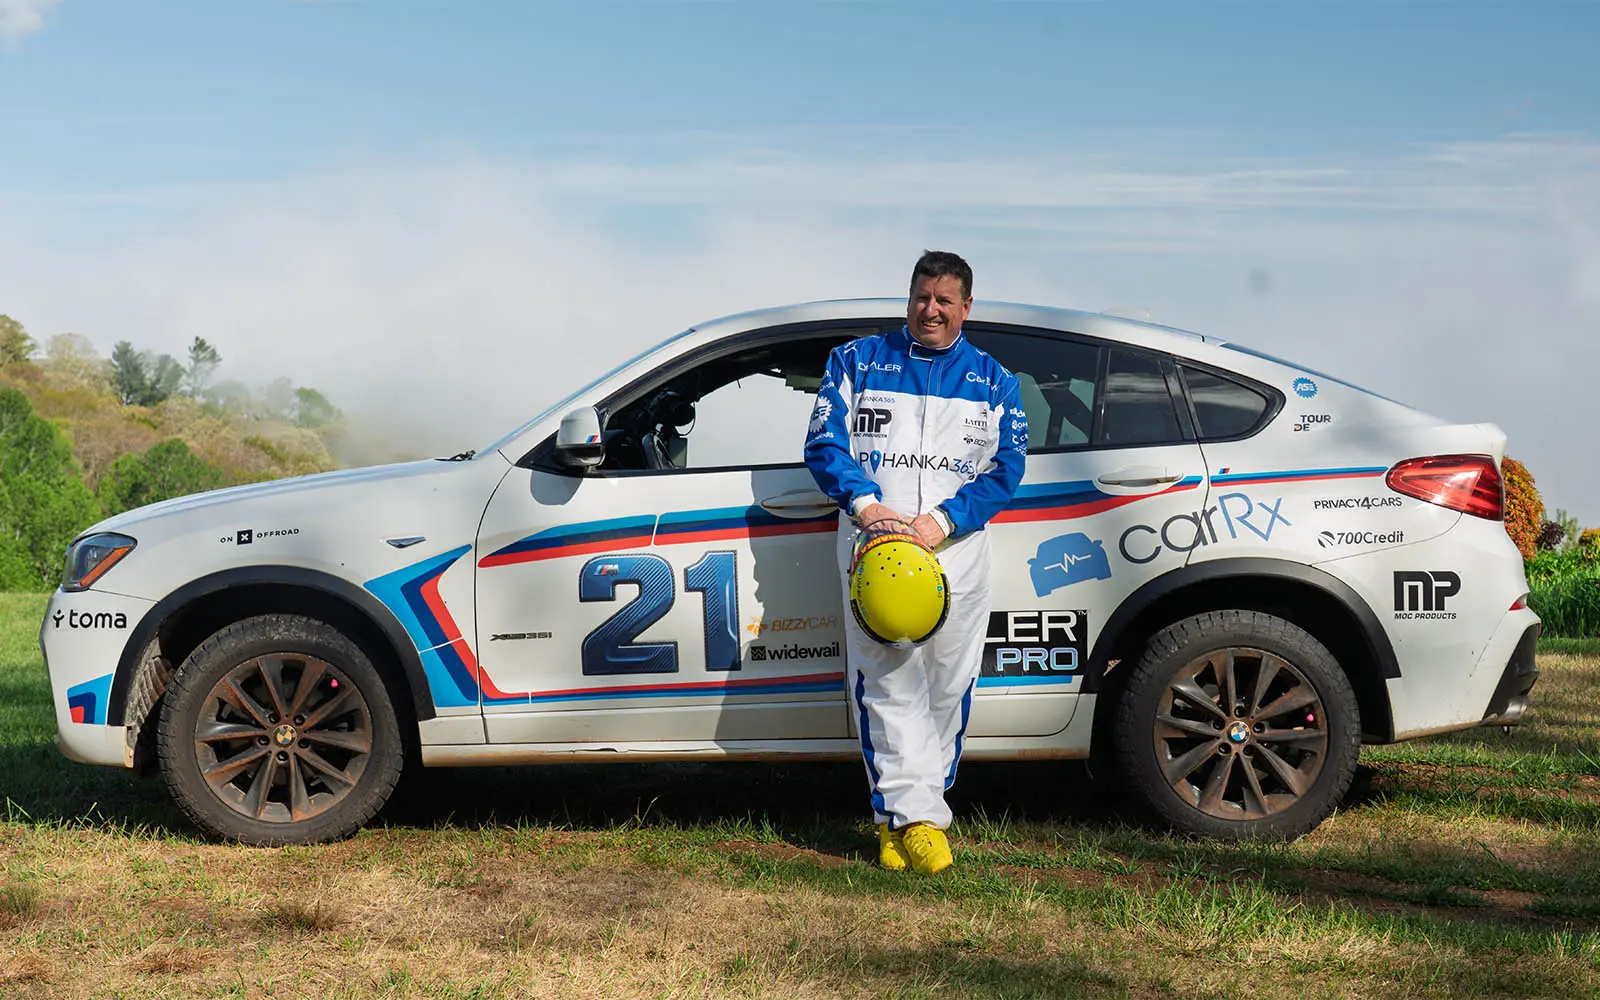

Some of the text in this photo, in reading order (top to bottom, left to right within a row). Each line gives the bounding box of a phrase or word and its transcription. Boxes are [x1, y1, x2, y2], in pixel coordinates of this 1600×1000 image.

[1293, 423, 1310, 432] DE
[1300, 414, 1332, 423] TOUR
[1314, 496, 1403, 509] PRIVACY4CARS
[256, 528, 300, 538] OFFROAD
[1119, 492, 1292, 564] carRx
[1336, 530, 1405, 545] 700Credit
[1393, 570, 1462, 611] MP
[69, 609, 128, 629] toma
[579, 549, 742, 676] 21
[1394, 612, 1457, 620] MOC PRODUCTS
[771, 615, 838, 633] BIZZYCAR
[767, 641, 840, 660] widewail
[995, 646, 1079, 672] PRO
